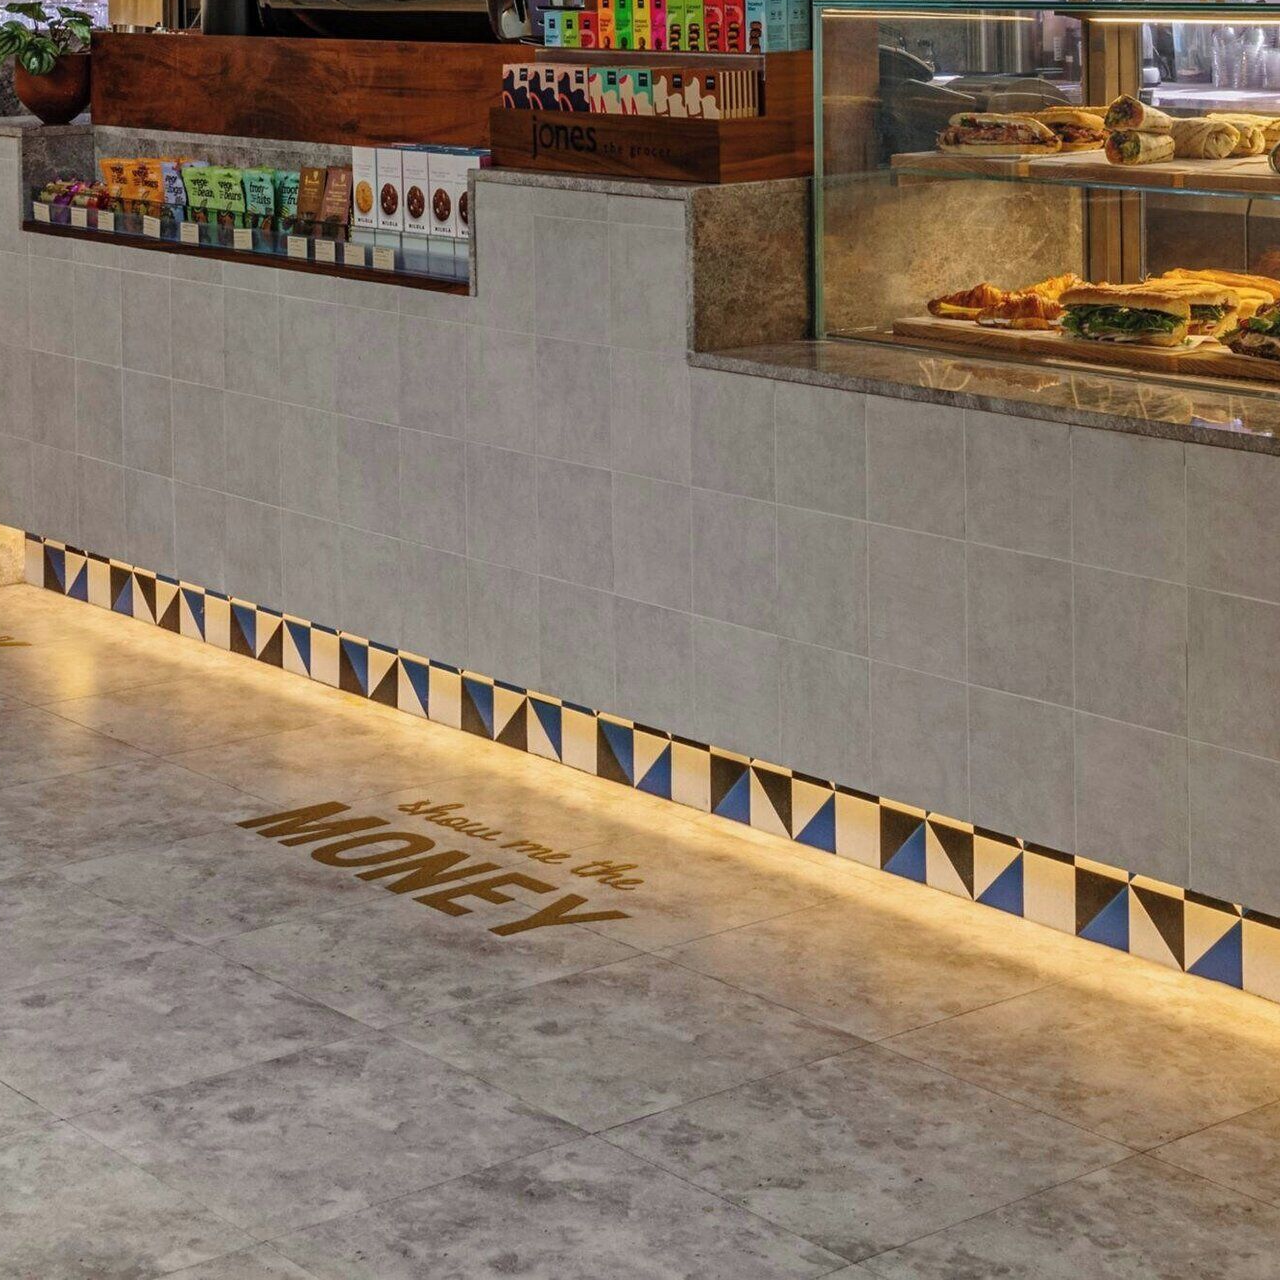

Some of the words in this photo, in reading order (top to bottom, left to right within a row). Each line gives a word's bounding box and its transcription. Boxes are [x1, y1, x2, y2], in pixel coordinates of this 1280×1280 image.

[532, 114, 598, 160] jones
[235, 801, 633, 937] MONEY
[397, 799, 502, 842] show
[500, 838, 573, 865] me
[570, 859, 646, 891] the
